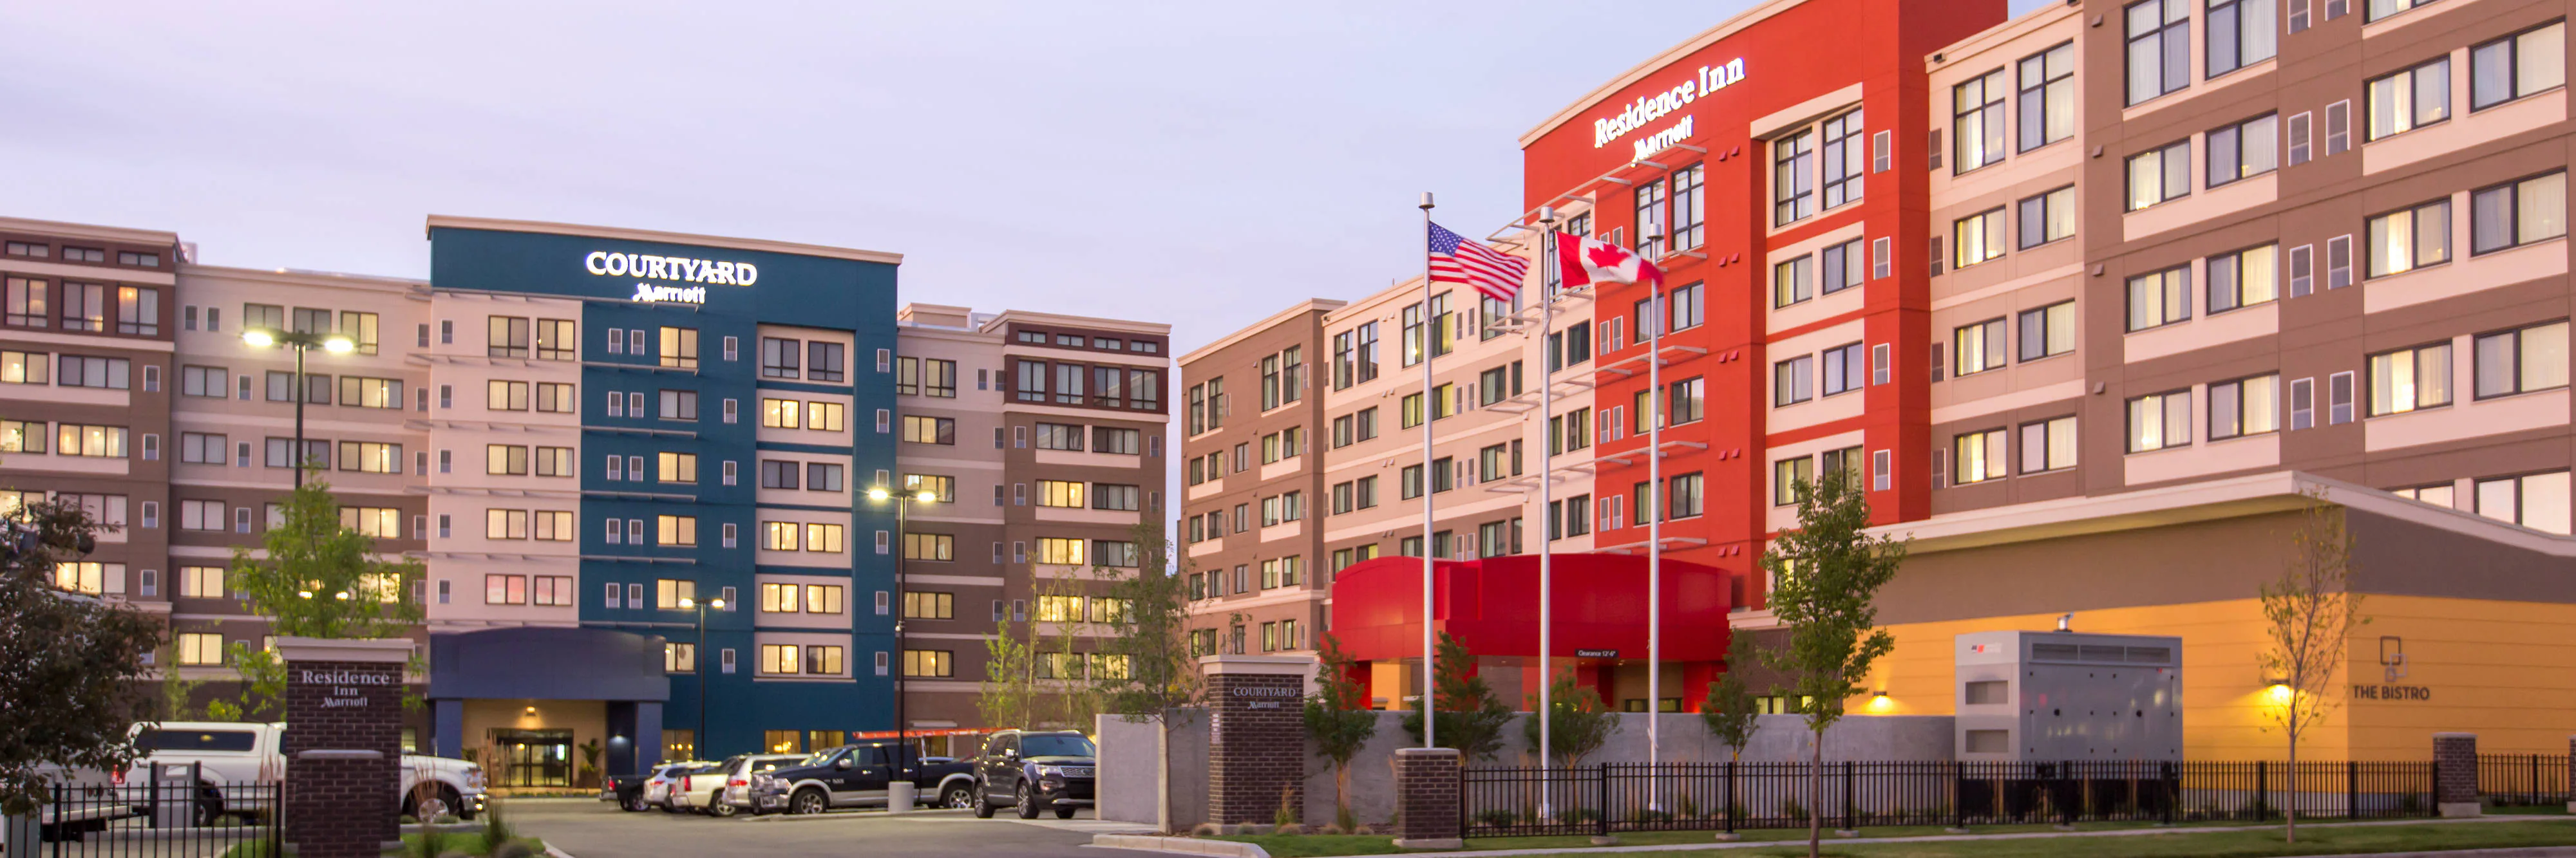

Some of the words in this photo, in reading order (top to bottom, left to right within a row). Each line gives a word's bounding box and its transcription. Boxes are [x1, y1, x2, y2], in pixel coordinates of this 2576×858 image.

[1594, 79, 1697, 148] Residence
[1698, 58, 1745, 97] Inn
[1630, 115, 1692, 167] Marriott
[585, 251, 758, 286] COURTYARD
[632, 283, 706, 304] Marriott
[301, 670, 390, 684] Residence
[334, 685, 358, 696] Inn
[1233, 687, 1296, 697] COURTYARD
[2353, 685, 2378, 699] THE
[2382, 685, 2430, 700] BISTRO
[321, 697, 368, 707] Marriott
[1248, 701, 1280, 710] Marriott
